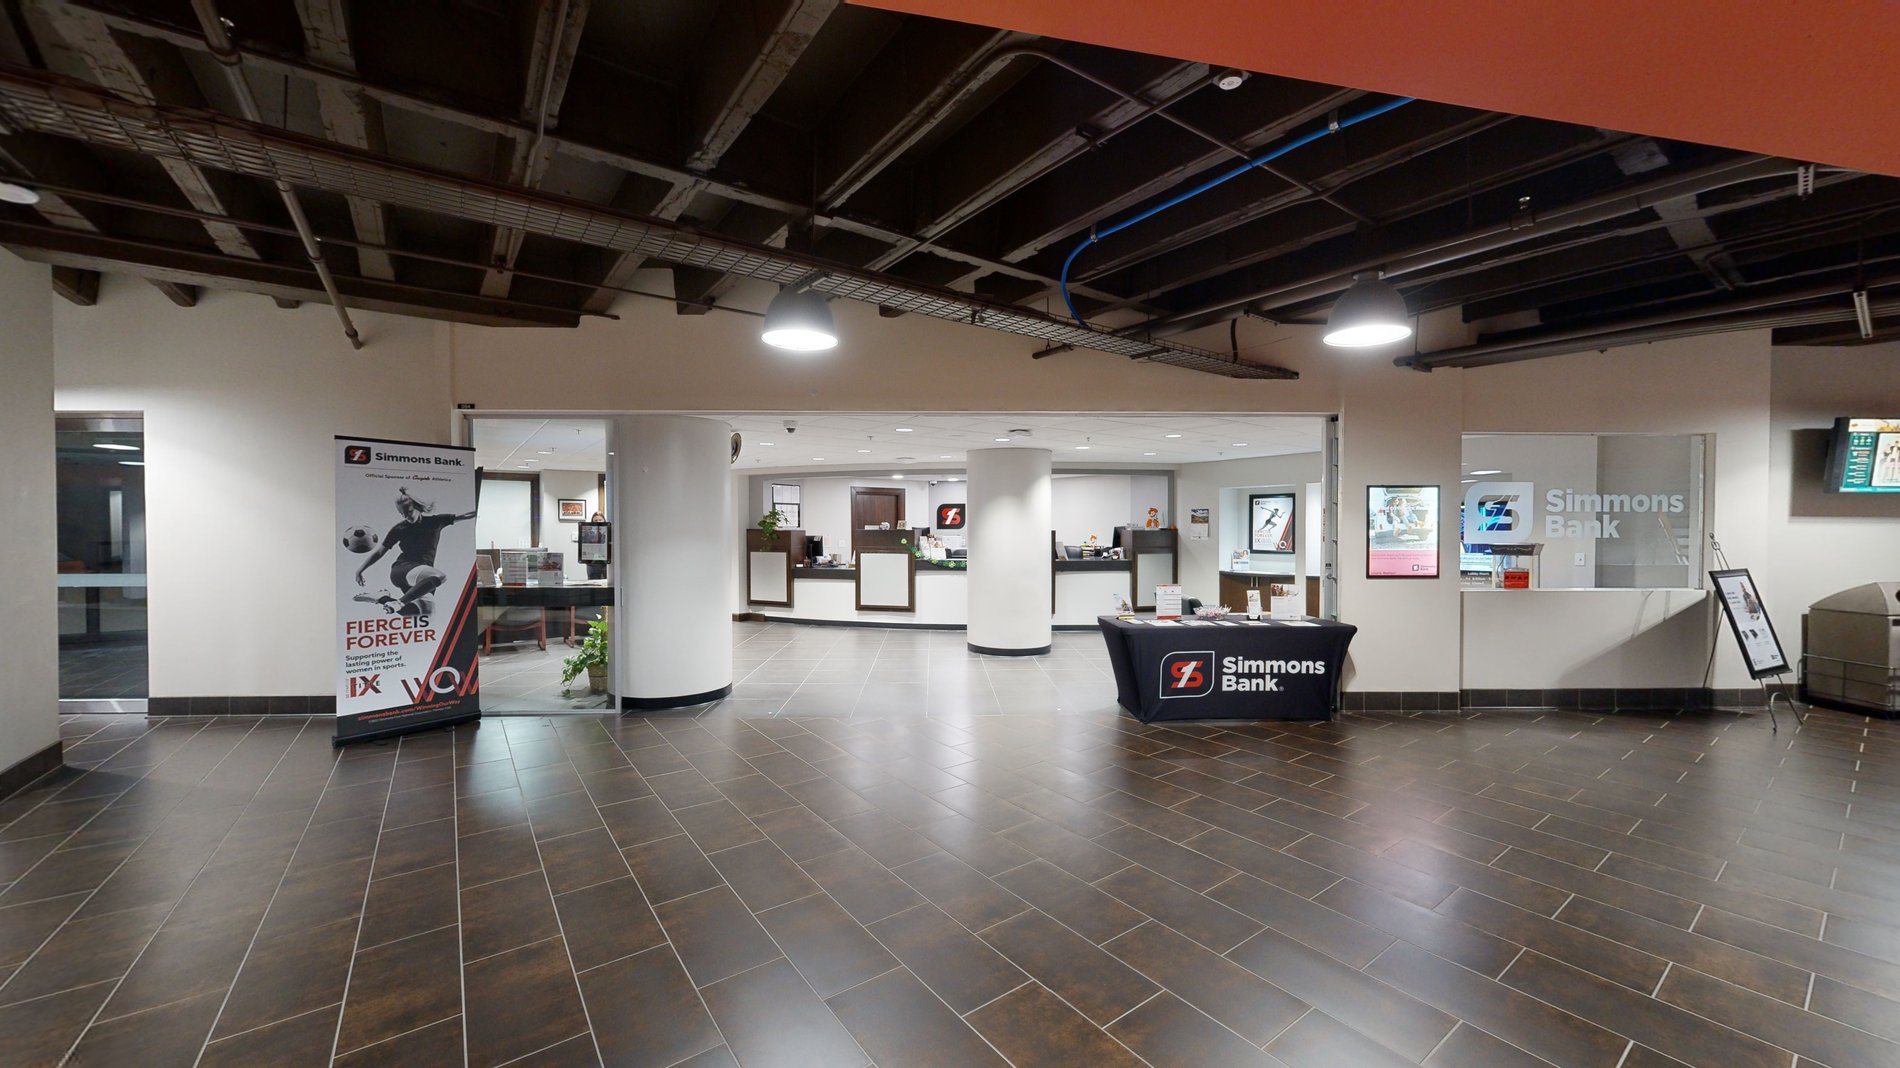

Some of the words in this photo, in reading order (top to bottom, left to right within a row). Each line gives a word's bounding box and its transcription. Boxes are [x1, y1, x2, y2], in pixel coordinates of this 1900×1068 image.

[375, 452, 431, 465] Simmons
[1545, 488, 1685, 513] Simmons
[1545, 514, 1621, 539] Bank
[346, 629, 437, 651] FOREVER
[345, 651, 386, 662] Supporting
[345, 659, 370, 668] lasting
[371, 657, 394, 665] power
[1222, 655, 1326, 675] Simmons
[345, 665, 373, 675] women
[374, 663, 381, 671] in
[382, 661, 407, 670] sports.
